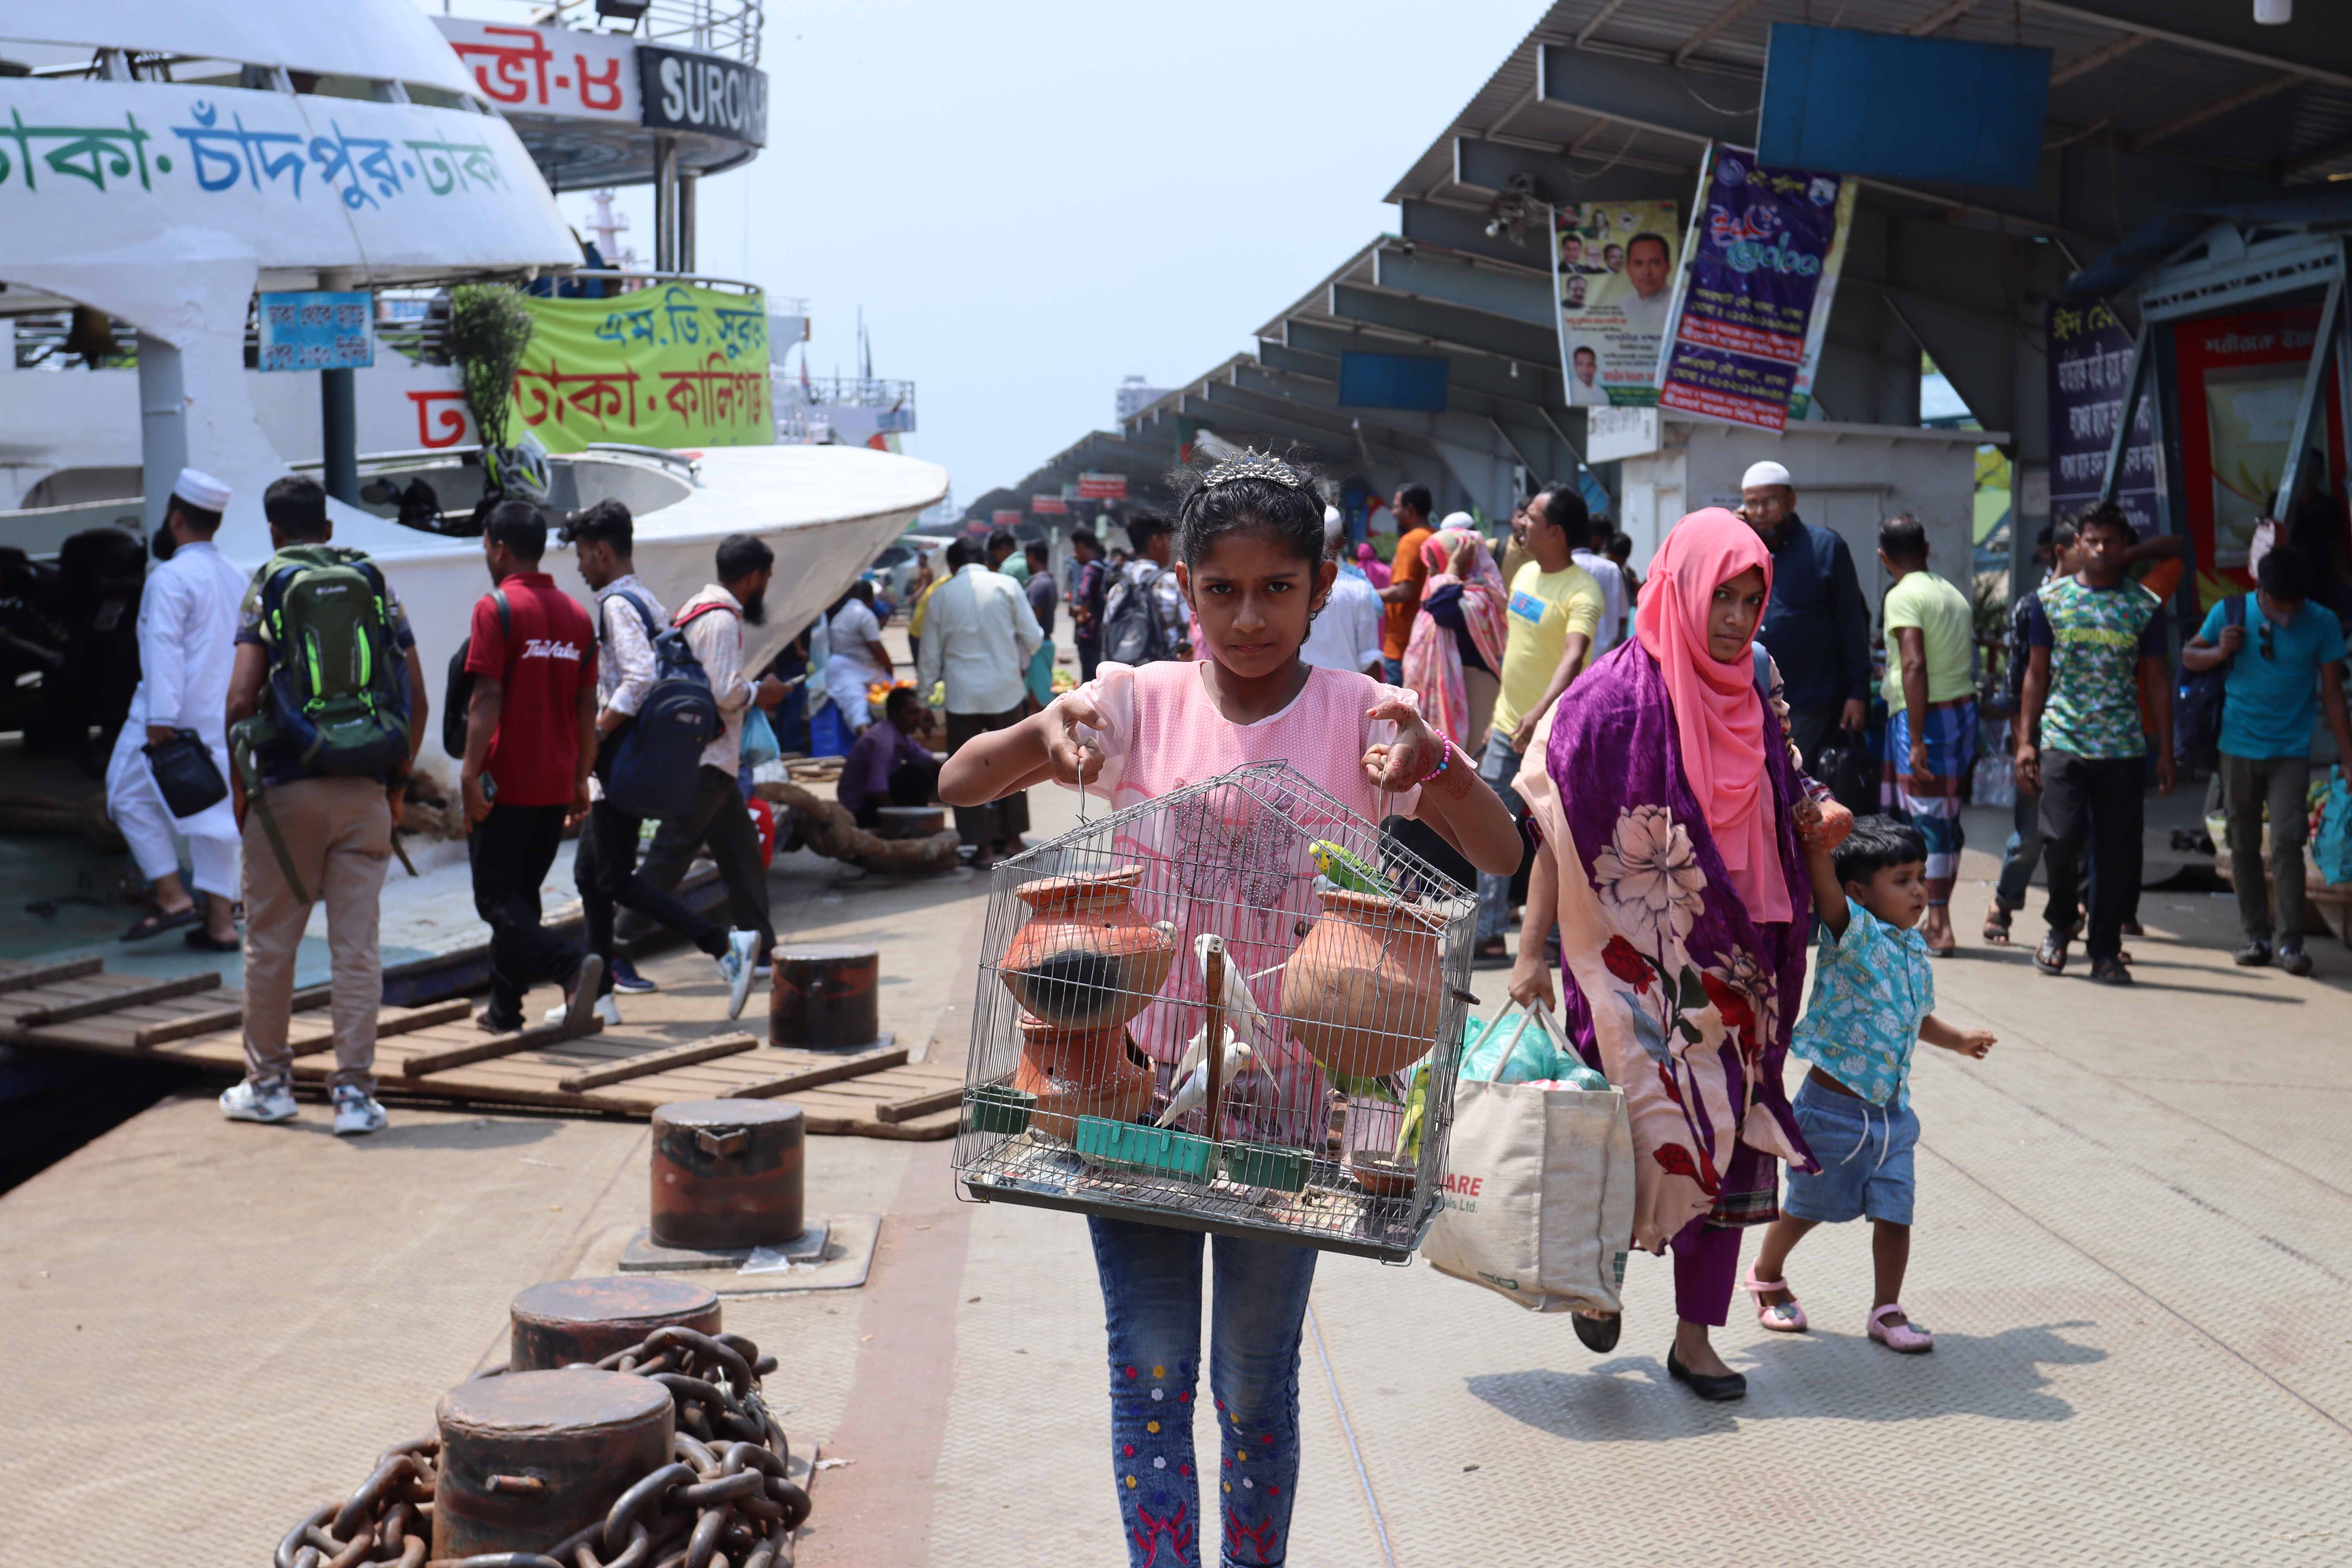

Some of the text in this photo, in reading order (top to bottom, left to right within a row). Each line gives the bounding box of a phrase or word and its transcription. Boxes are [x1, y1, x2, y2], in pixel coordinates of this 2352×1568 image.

[171, 99, 403, 211] চাঁদপুর
[1442, 1172, 1484, 1197] ARE
[1460, 1198, 1478, 1213] Ltd.
